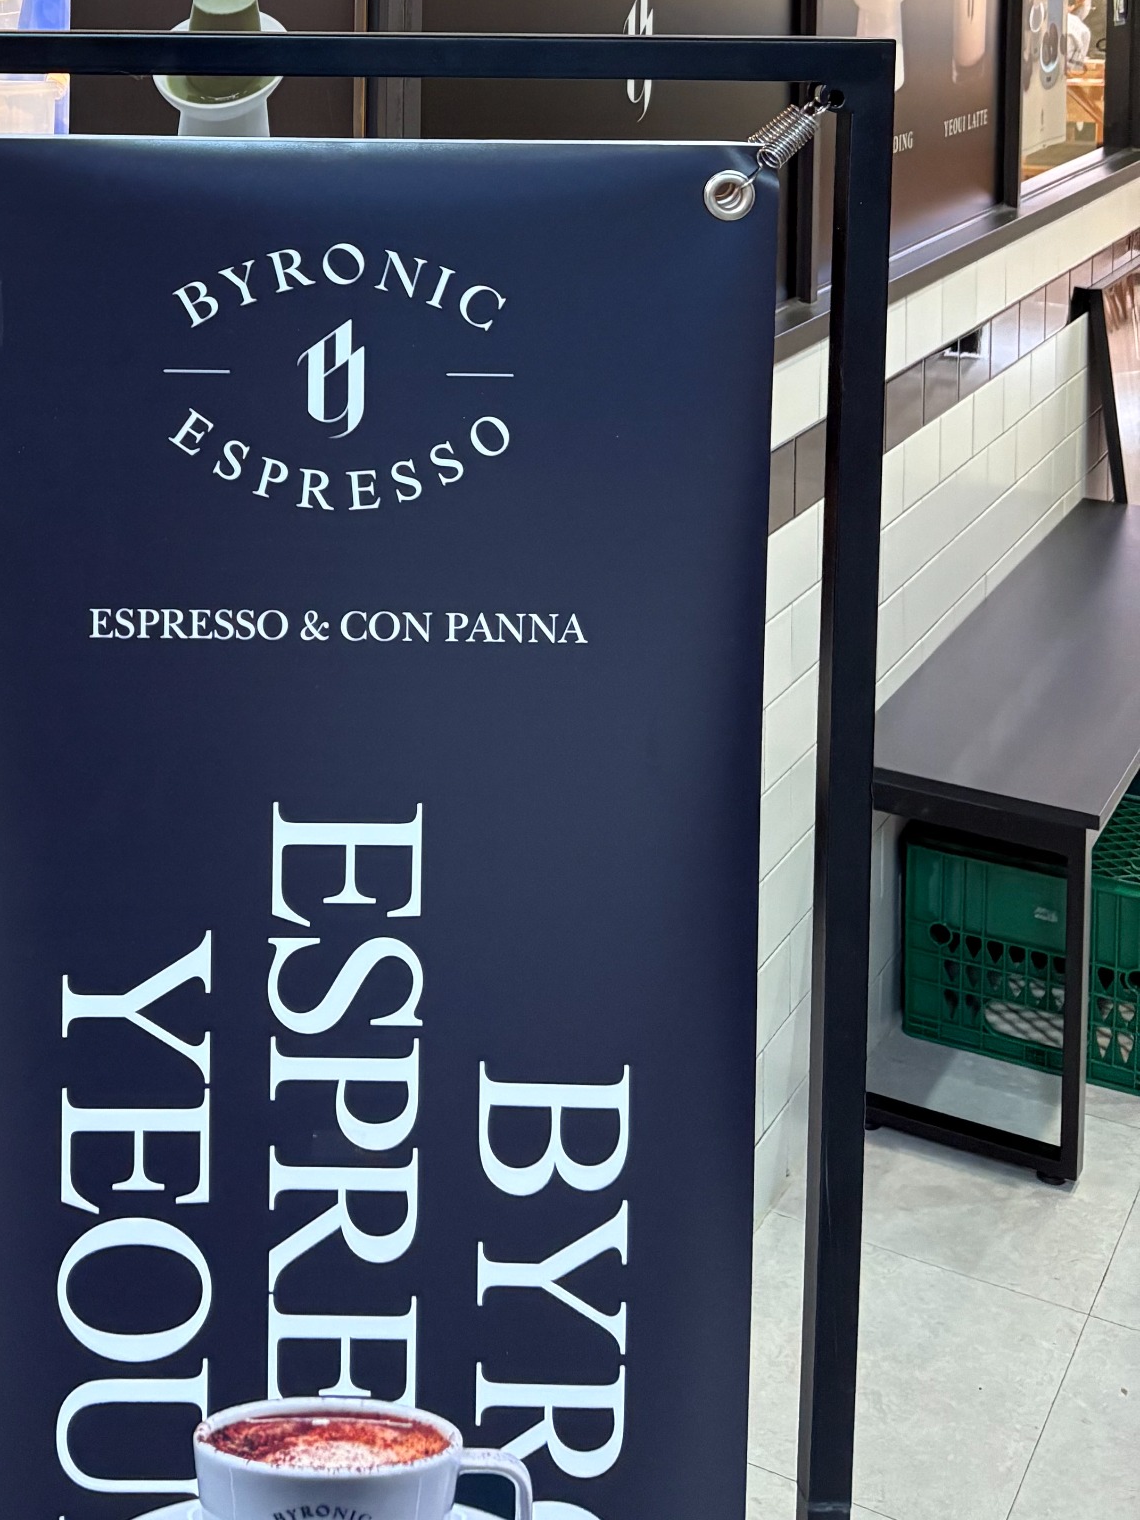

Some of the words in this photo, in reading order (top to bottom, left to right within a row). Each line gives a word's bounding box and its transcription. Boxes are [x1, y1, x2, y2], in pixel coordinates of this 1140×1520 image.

[892, 130, 914, 154] DING
[943, 115, 966, 138] YEOUI
[967, 108, 988, 130] LATTE
[172, 242, 507, 331] BYRONIC
[168, 408, 510, 512] ESPRESSO
[89, 608, 289, 641] ESPRESSO
[300, 611, 329, 641] &
[340, 610, 432, 642] CON
[445, 612, 588, 644] PANNA
[56, 930, 213, 1520] YEOU
[474, 1060, 630, 1520] BYR
